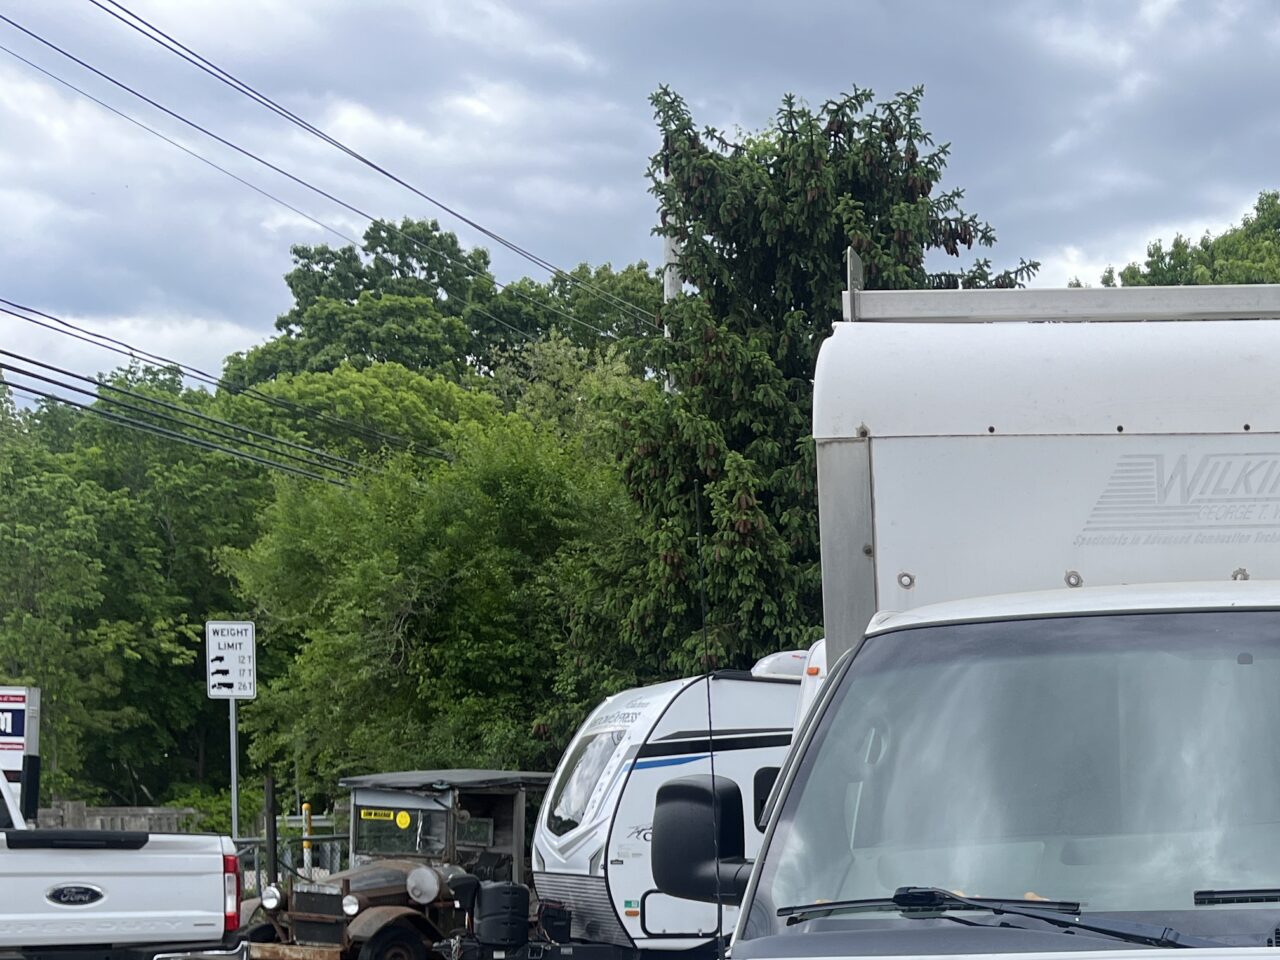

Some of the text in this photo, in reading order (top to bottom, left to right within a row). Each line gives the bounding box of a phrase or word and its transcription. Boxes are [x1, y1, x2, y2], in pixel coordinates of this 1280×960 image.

[1199, 503, 1255, 520] GEORGE
[1257, 503, 1268, 519] T.
[1193, 532, 1251, 545] Combustion
[212, 628, 249, 637] WEIGHT
[218, 642, 243, 651] LIMIT
[60, 887, 92, 902] Ford
[96, 918, 184, 932] DUTY
